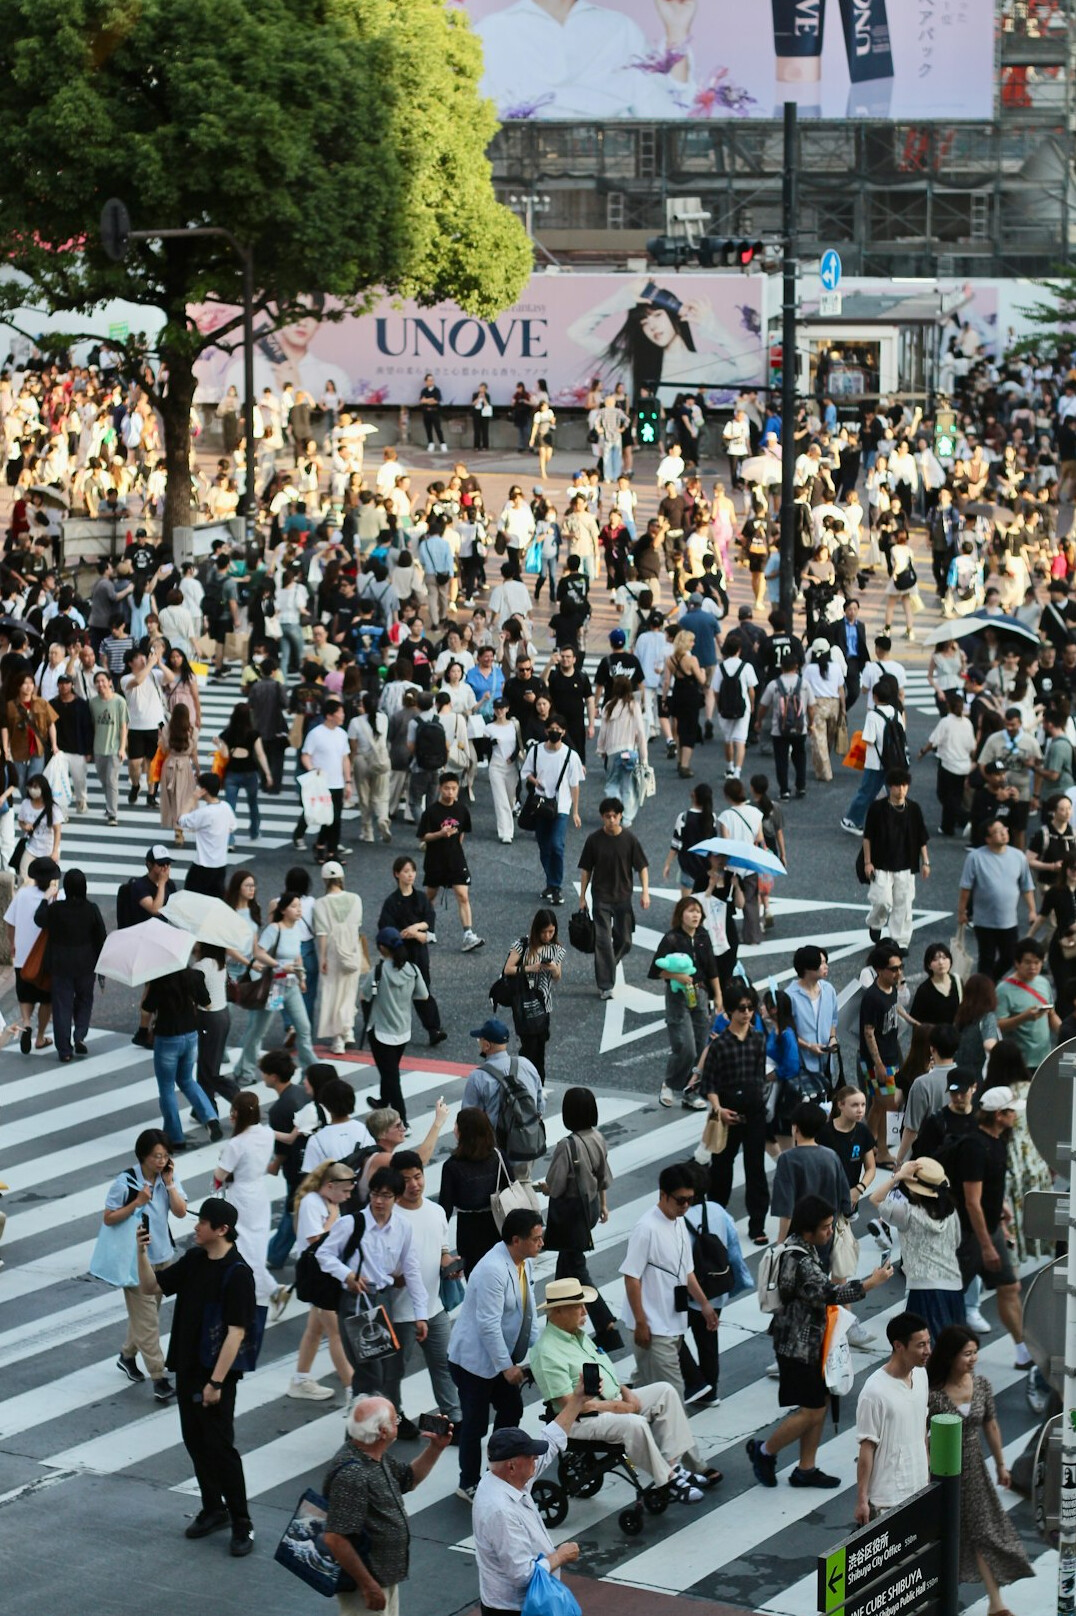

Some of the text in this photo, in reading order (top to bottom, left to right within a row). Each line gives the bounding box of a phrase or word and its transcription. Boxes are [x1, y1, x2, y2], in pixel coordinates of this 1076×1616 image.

[375, 318, 548, 358] UNOVE
[847, 1563, 872, 1585] Shibuya
[872, 1554, 884, 1568] City
[884, 1543, 902, 1560] Office
[848, 1531, 889, 1571] 渋谷区役所
[865, 1567, 923, 1615] CUBE SHIBUYA
[900, 1590, 915, 1608] Public
[915, 1581, 926, 1597] Hall
